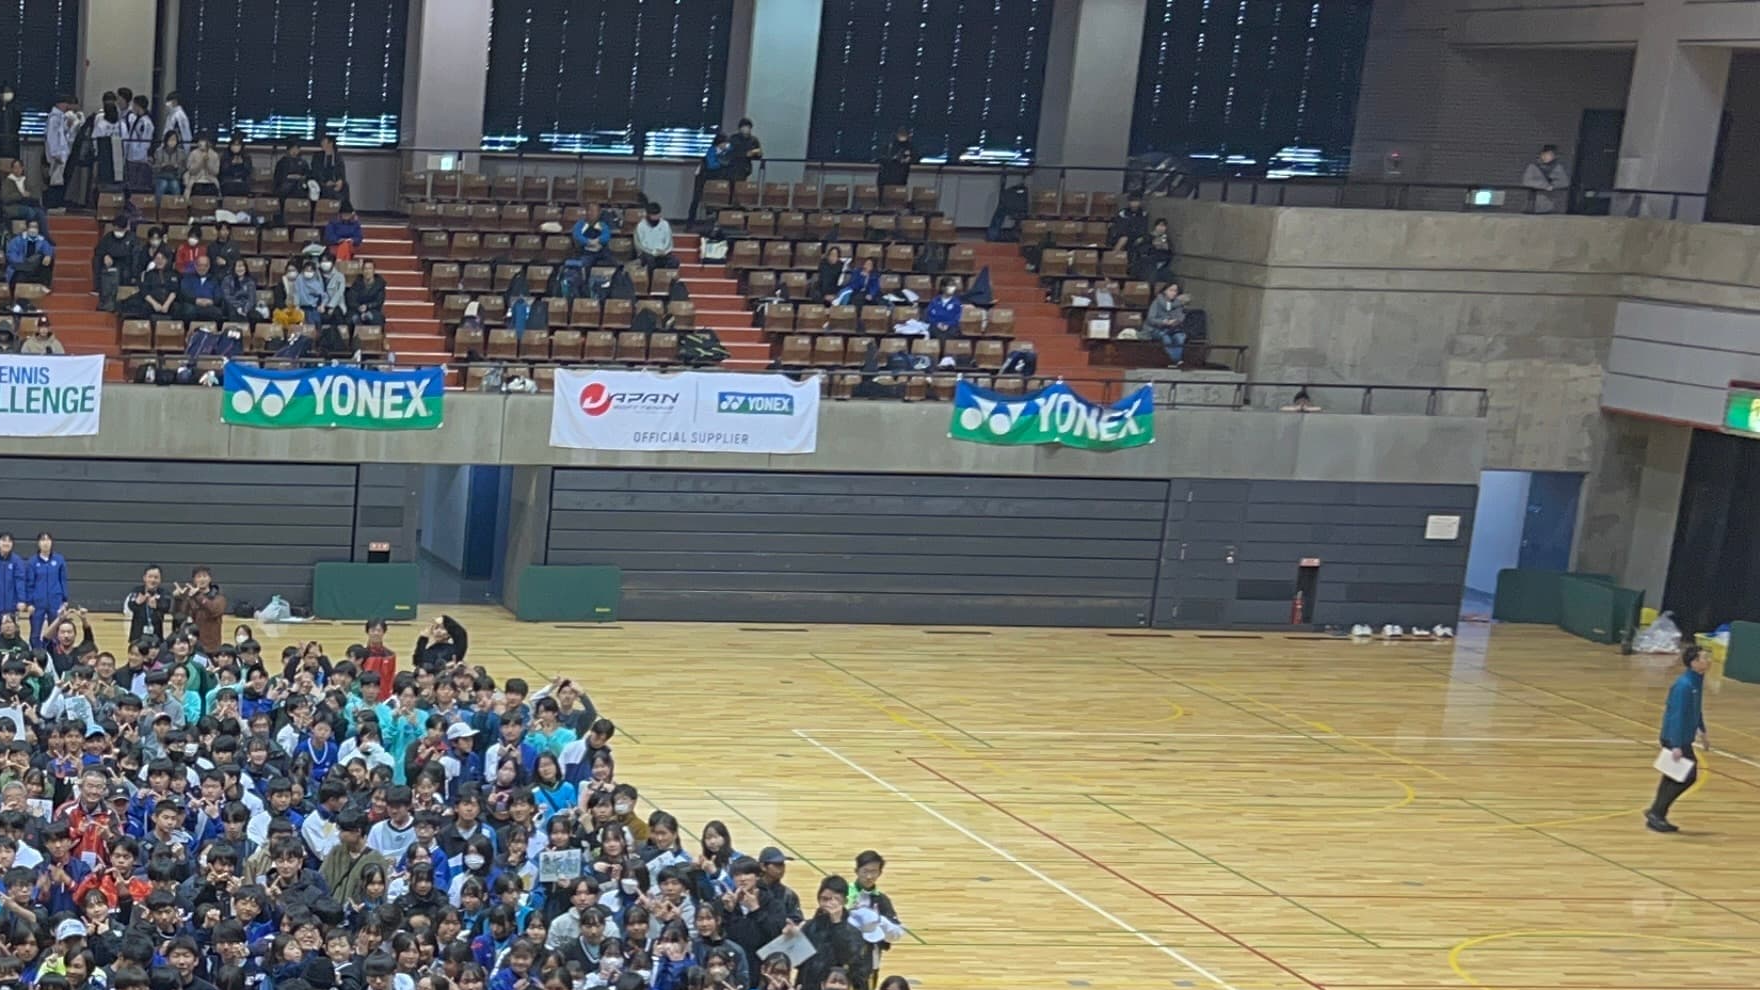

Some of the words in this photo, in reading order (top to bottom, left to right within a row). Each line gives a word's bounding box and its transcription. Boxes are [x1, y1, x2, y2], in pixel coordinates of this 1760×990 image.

[308, 375, 431, 419] YONEX
[748, 396, 791, 412] YONEX
[1034, 393, 1142, 441] YONEX
[633, 431, 687, 443] OFFICIAL
[691, 432, 749, 445] SUPPLIER
